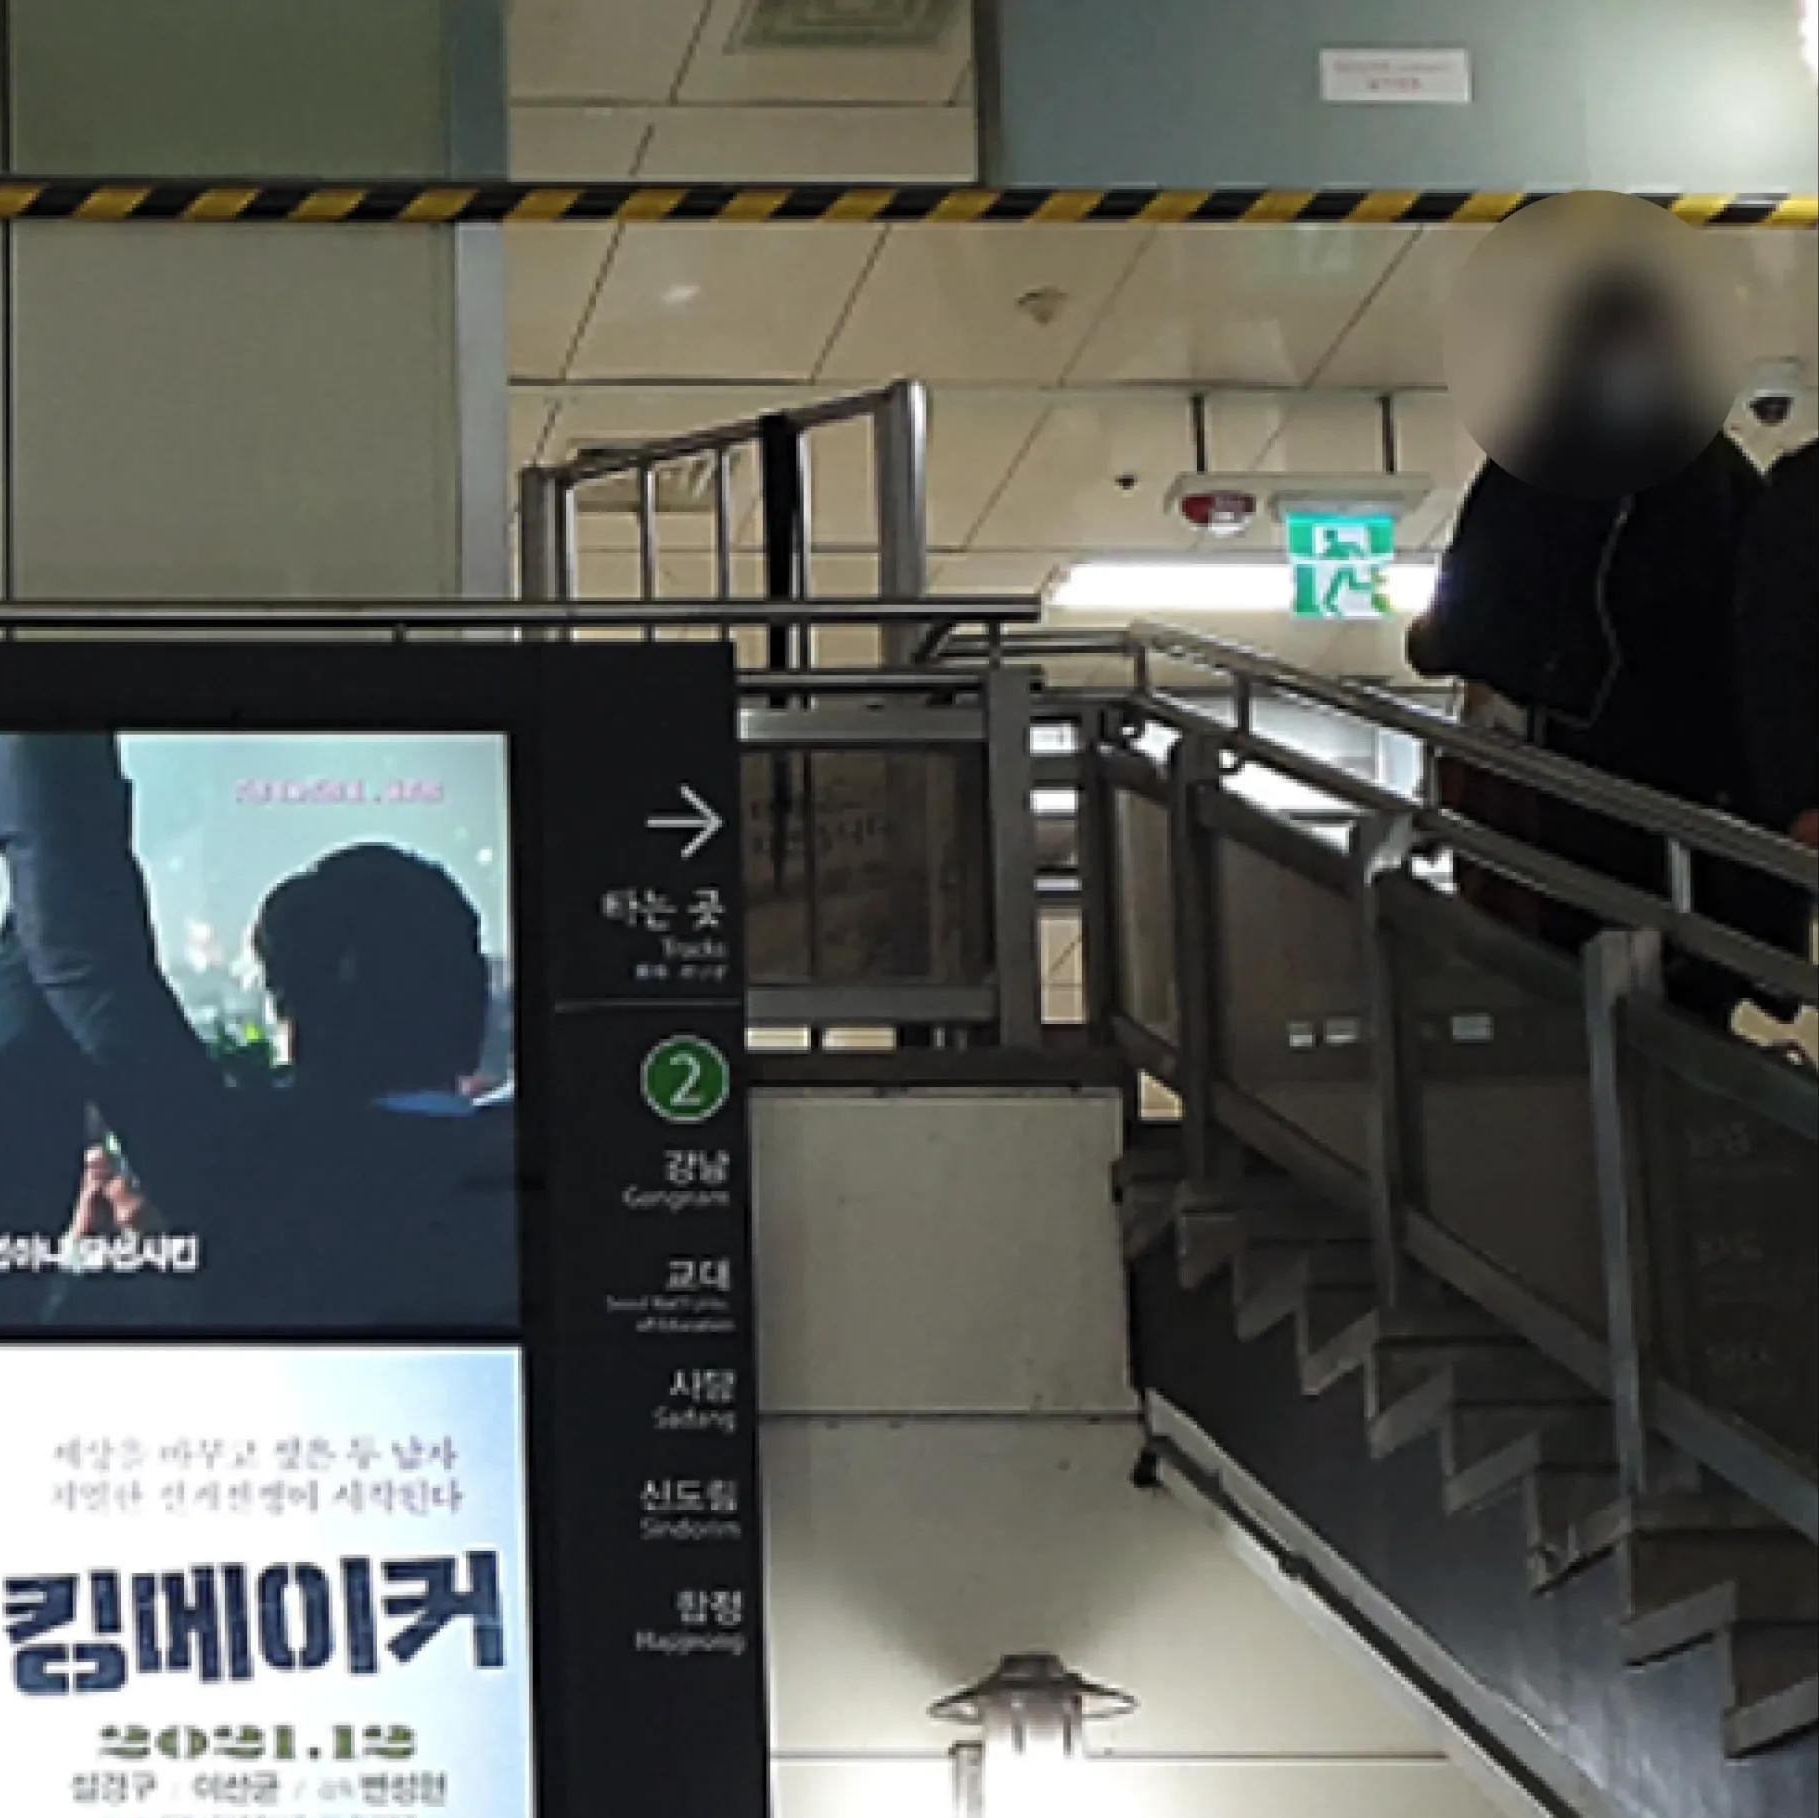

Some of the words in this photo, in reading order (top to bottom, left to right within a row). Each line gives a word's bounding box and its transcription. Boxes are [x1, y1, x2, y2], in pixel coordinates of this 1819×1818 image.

[602, 887, 677, 931] 타는
[686, 887, 726, 930] 곳
[664, 1150, 730, 1183] 강남
[665, 1257, 731, 1292] 교대
[669, 1367, 737, 1402] 사당
[347, 1434, 381, 1471] 두
[391, 1434, 459, 1472] 남자
[3, 1550, 507, 1696] 킹메이커
[99, 1724, 419, 1761] 2021.12
